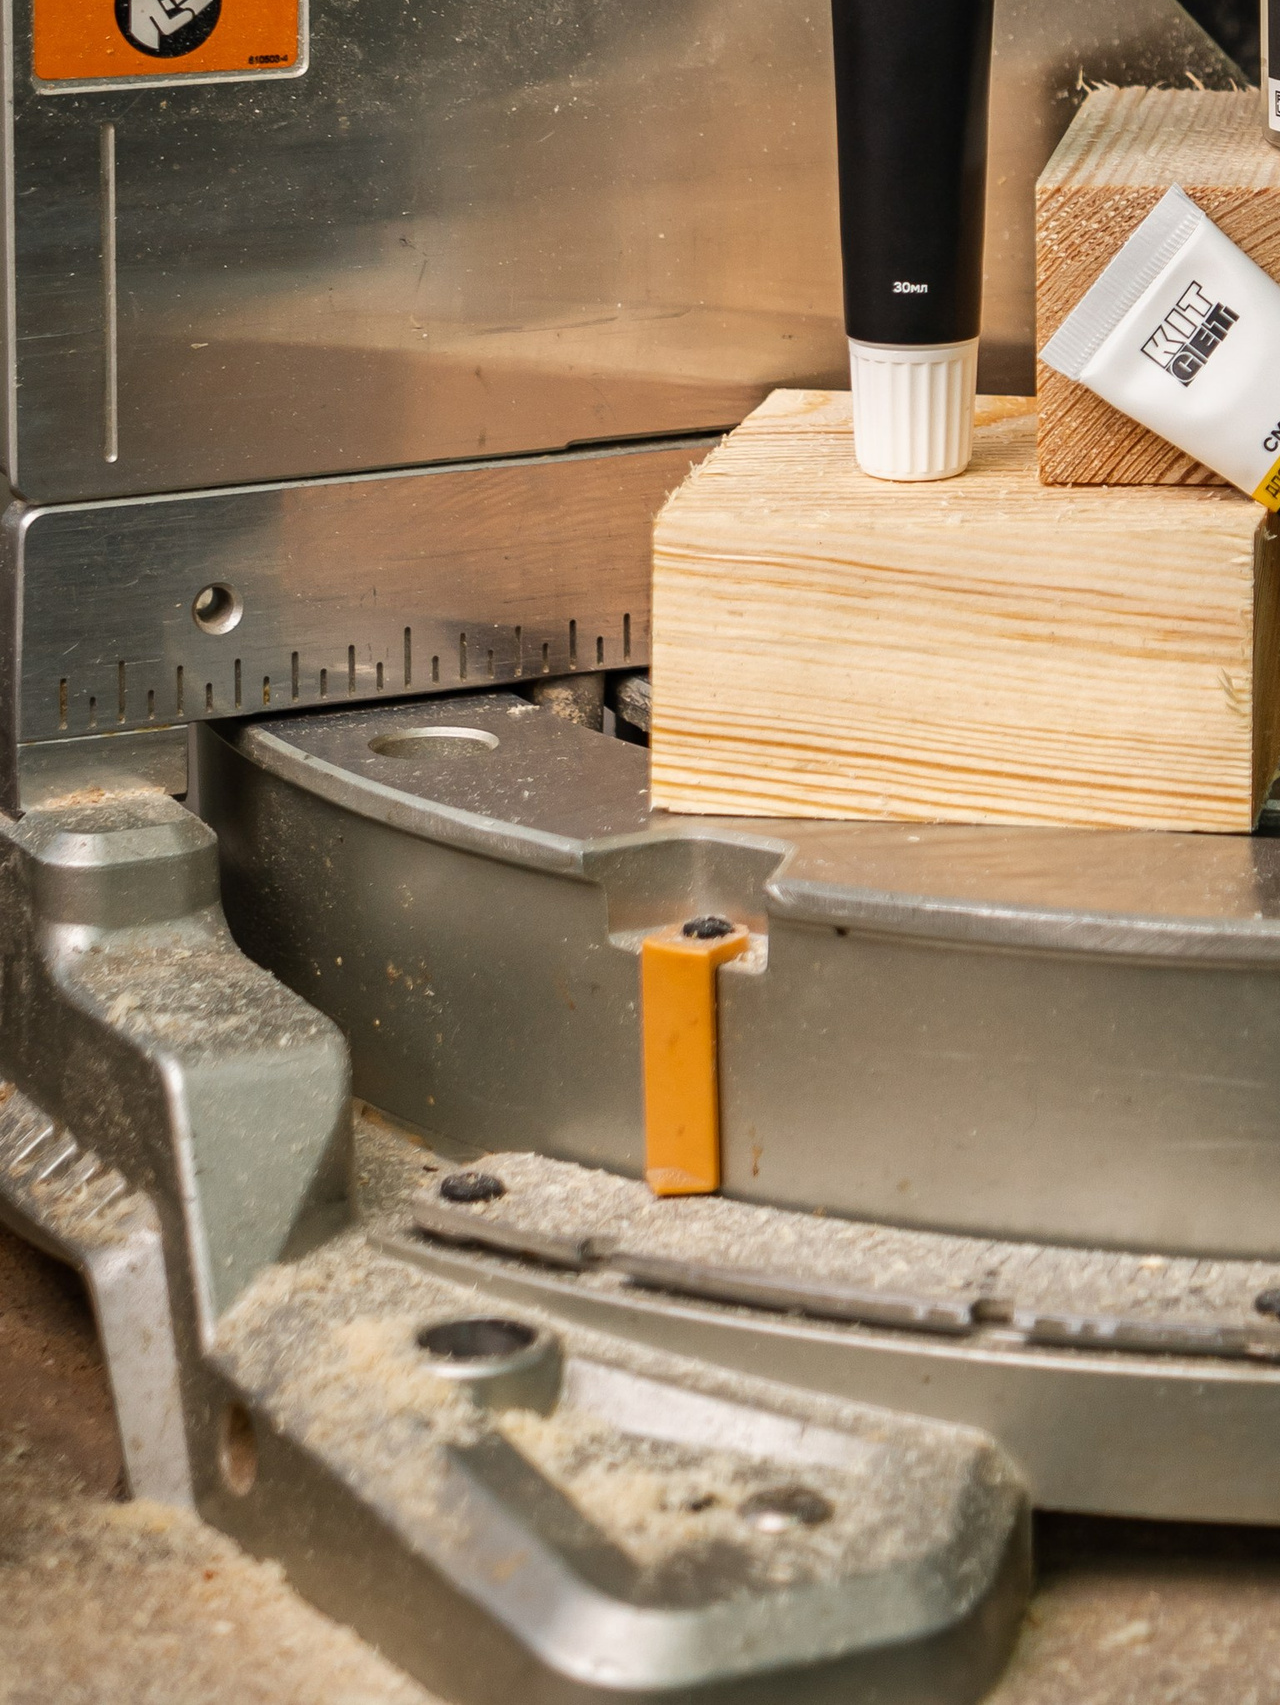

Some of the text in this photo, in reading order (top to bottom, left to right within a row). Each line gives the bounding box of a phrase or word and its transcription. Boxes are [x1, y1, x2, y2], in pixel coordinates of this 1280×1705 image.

[892, 281, 929, 293] 30мл
[1141, 280, 1213, 369] KIT
[1165, 301, 1240, 388] GET
